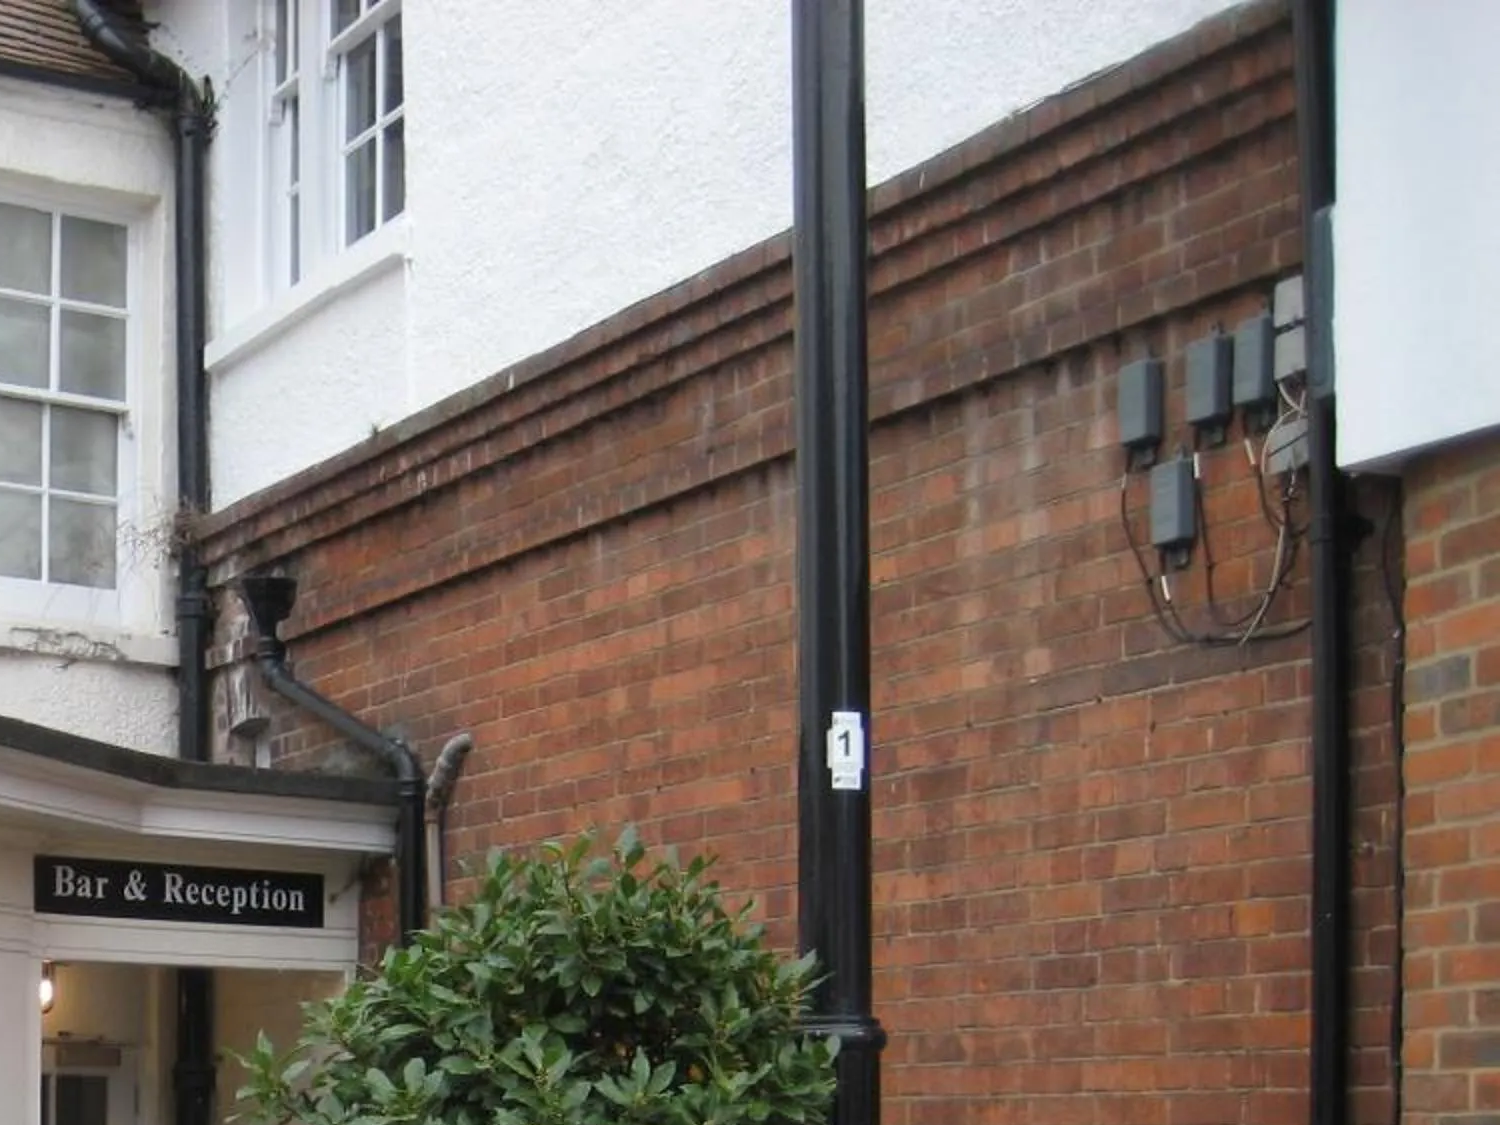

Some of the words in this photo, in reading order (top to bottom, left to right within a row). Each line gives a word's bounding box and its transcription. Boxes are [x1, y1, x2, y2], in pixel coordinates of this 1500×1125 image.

[838, 729, 851, 757] 1
[52, 864, 109, 899] Bar
[123, 868, 148, 902] &
[163, 872, 306, 915] Reception
